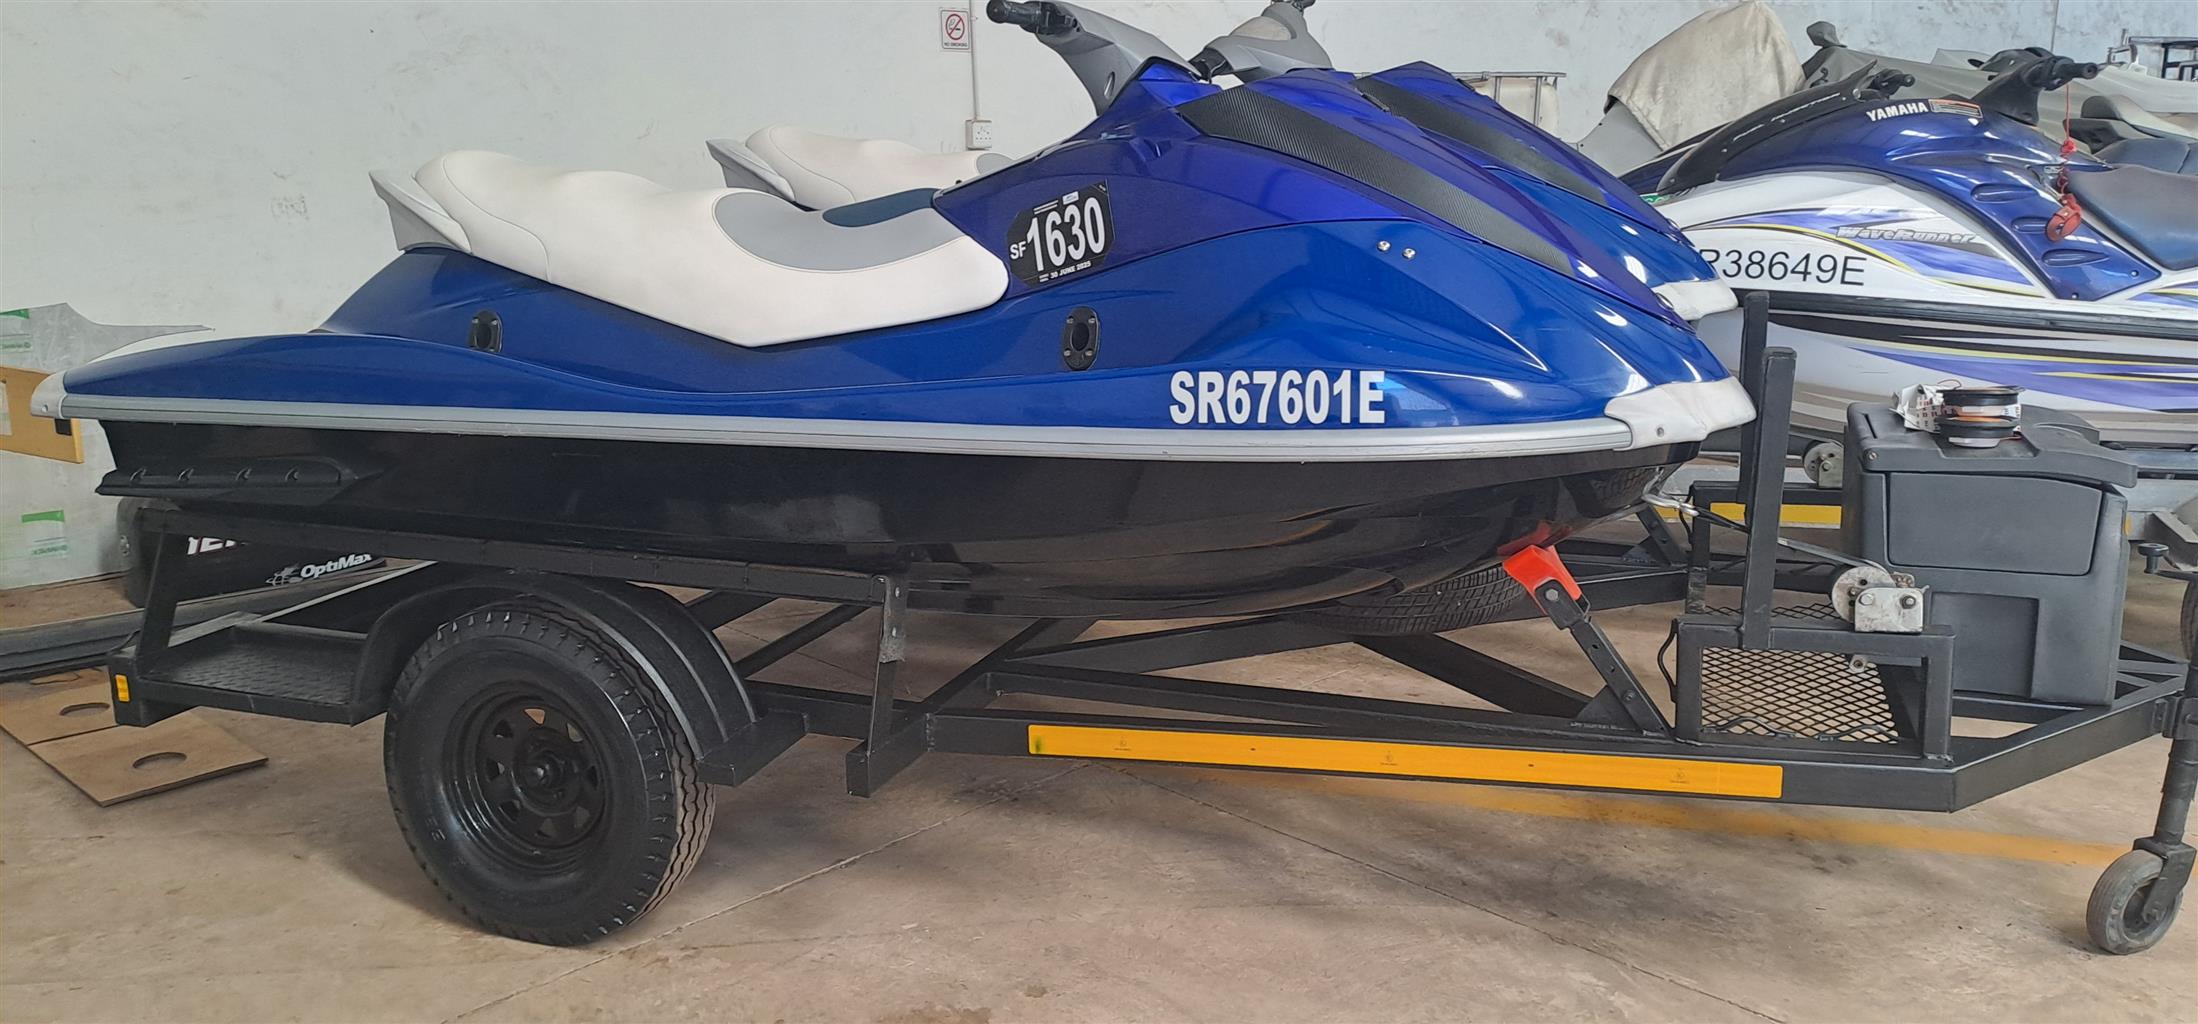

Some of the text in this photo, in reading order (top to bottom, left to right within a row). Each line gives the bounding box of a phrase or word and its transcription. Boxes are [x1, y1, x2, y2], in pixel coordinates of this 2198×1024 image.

[1866, 102, 1928, 121] YAMAHA
[1010, 197, 1105, 271] SF 1630
[1836, 226, 1976, 244] WaveRunner
[1059, 265, 1075, 276] JUNE
[1169, 369, 1385, 424] SR67601E
[300, 553, 372, 579] OptiMax
